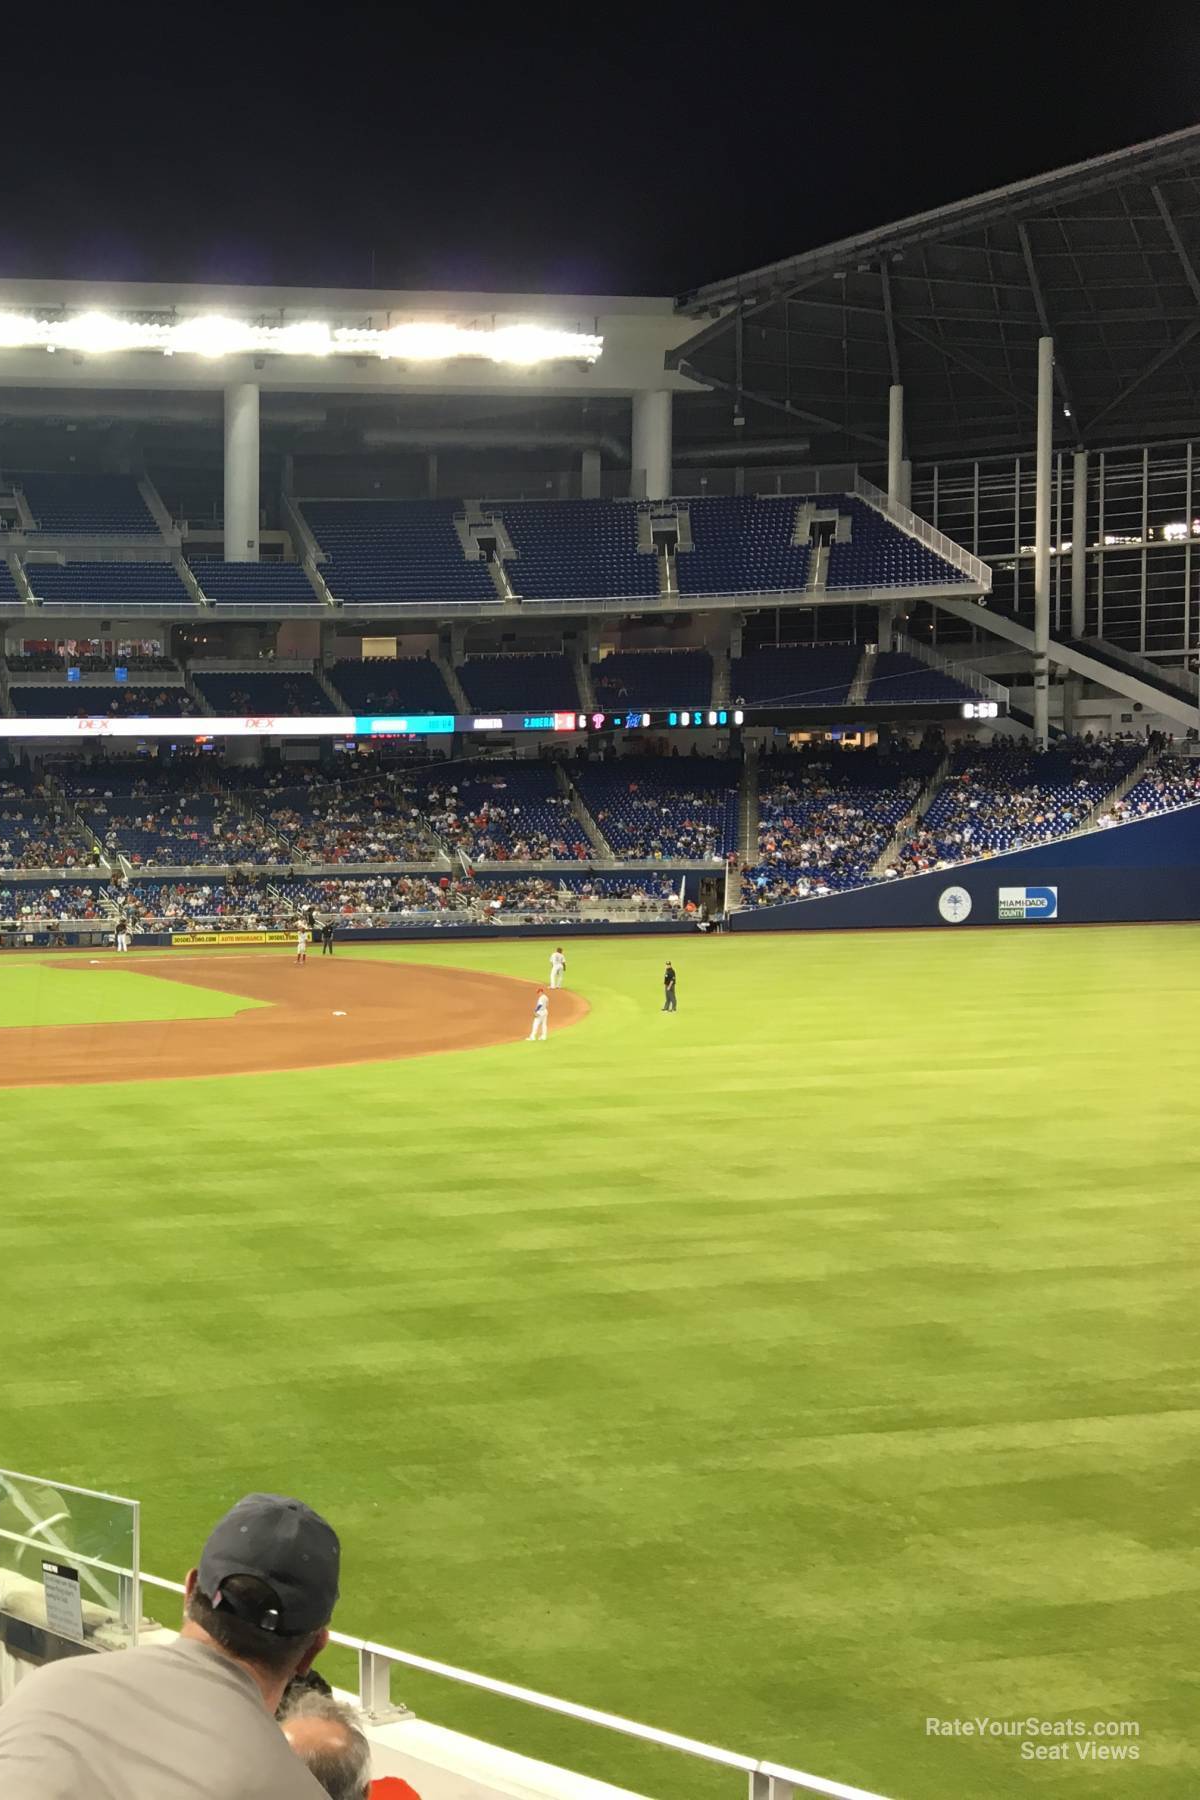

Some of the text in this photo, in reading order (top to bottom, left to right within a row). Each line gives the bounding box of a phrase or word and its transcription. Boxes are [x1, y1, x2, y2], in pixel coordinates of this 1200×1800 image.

[78, 719, 109, 729] DEX
[245, 719, 274, 728] DEX
[1000, 908, 1024, 917] COUNTY
